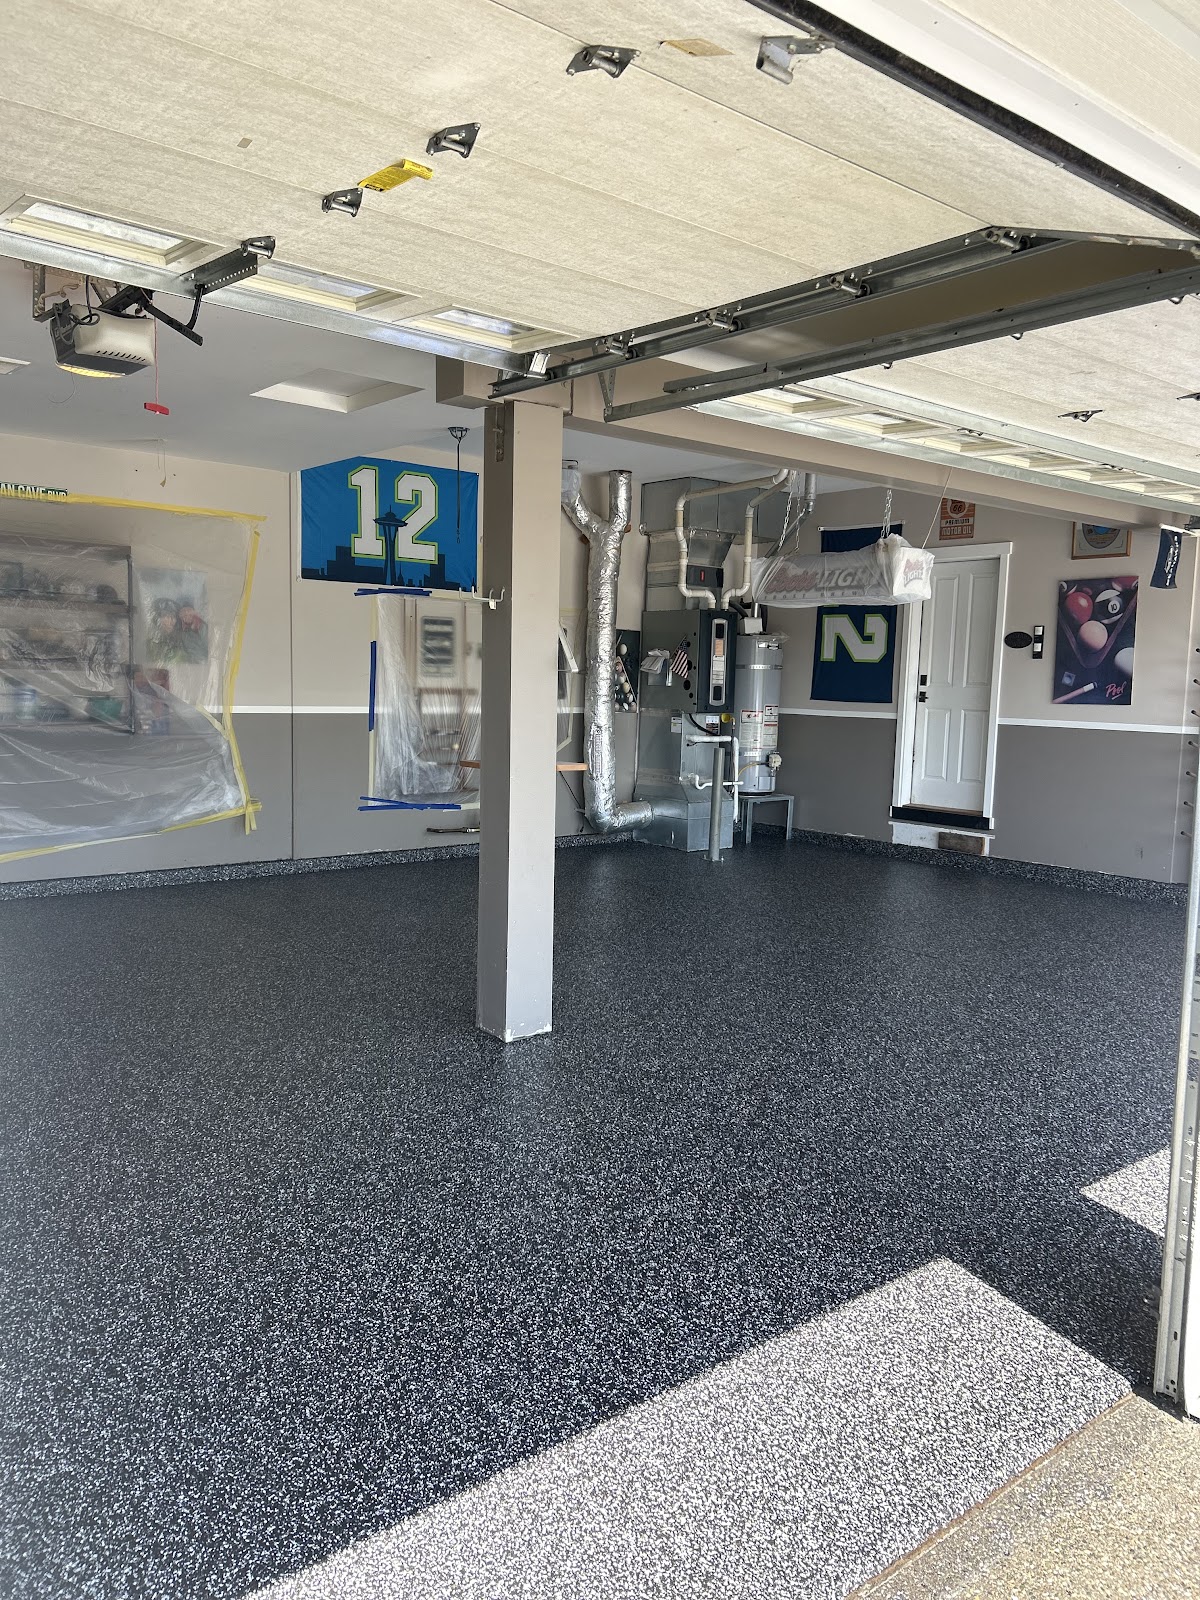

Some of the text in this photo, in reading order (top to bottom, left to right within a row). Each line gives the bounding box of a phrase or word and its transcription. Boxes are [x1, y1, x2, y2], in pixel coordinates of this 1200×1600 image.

[18, 485, 46, 499] CAVE
[347, 465, 438, 564] 12
[941, 525, 972, 536] MOTOR OIL
[1110, 603, 1118, 611] 10
[820, 613, 888, 663] 2
